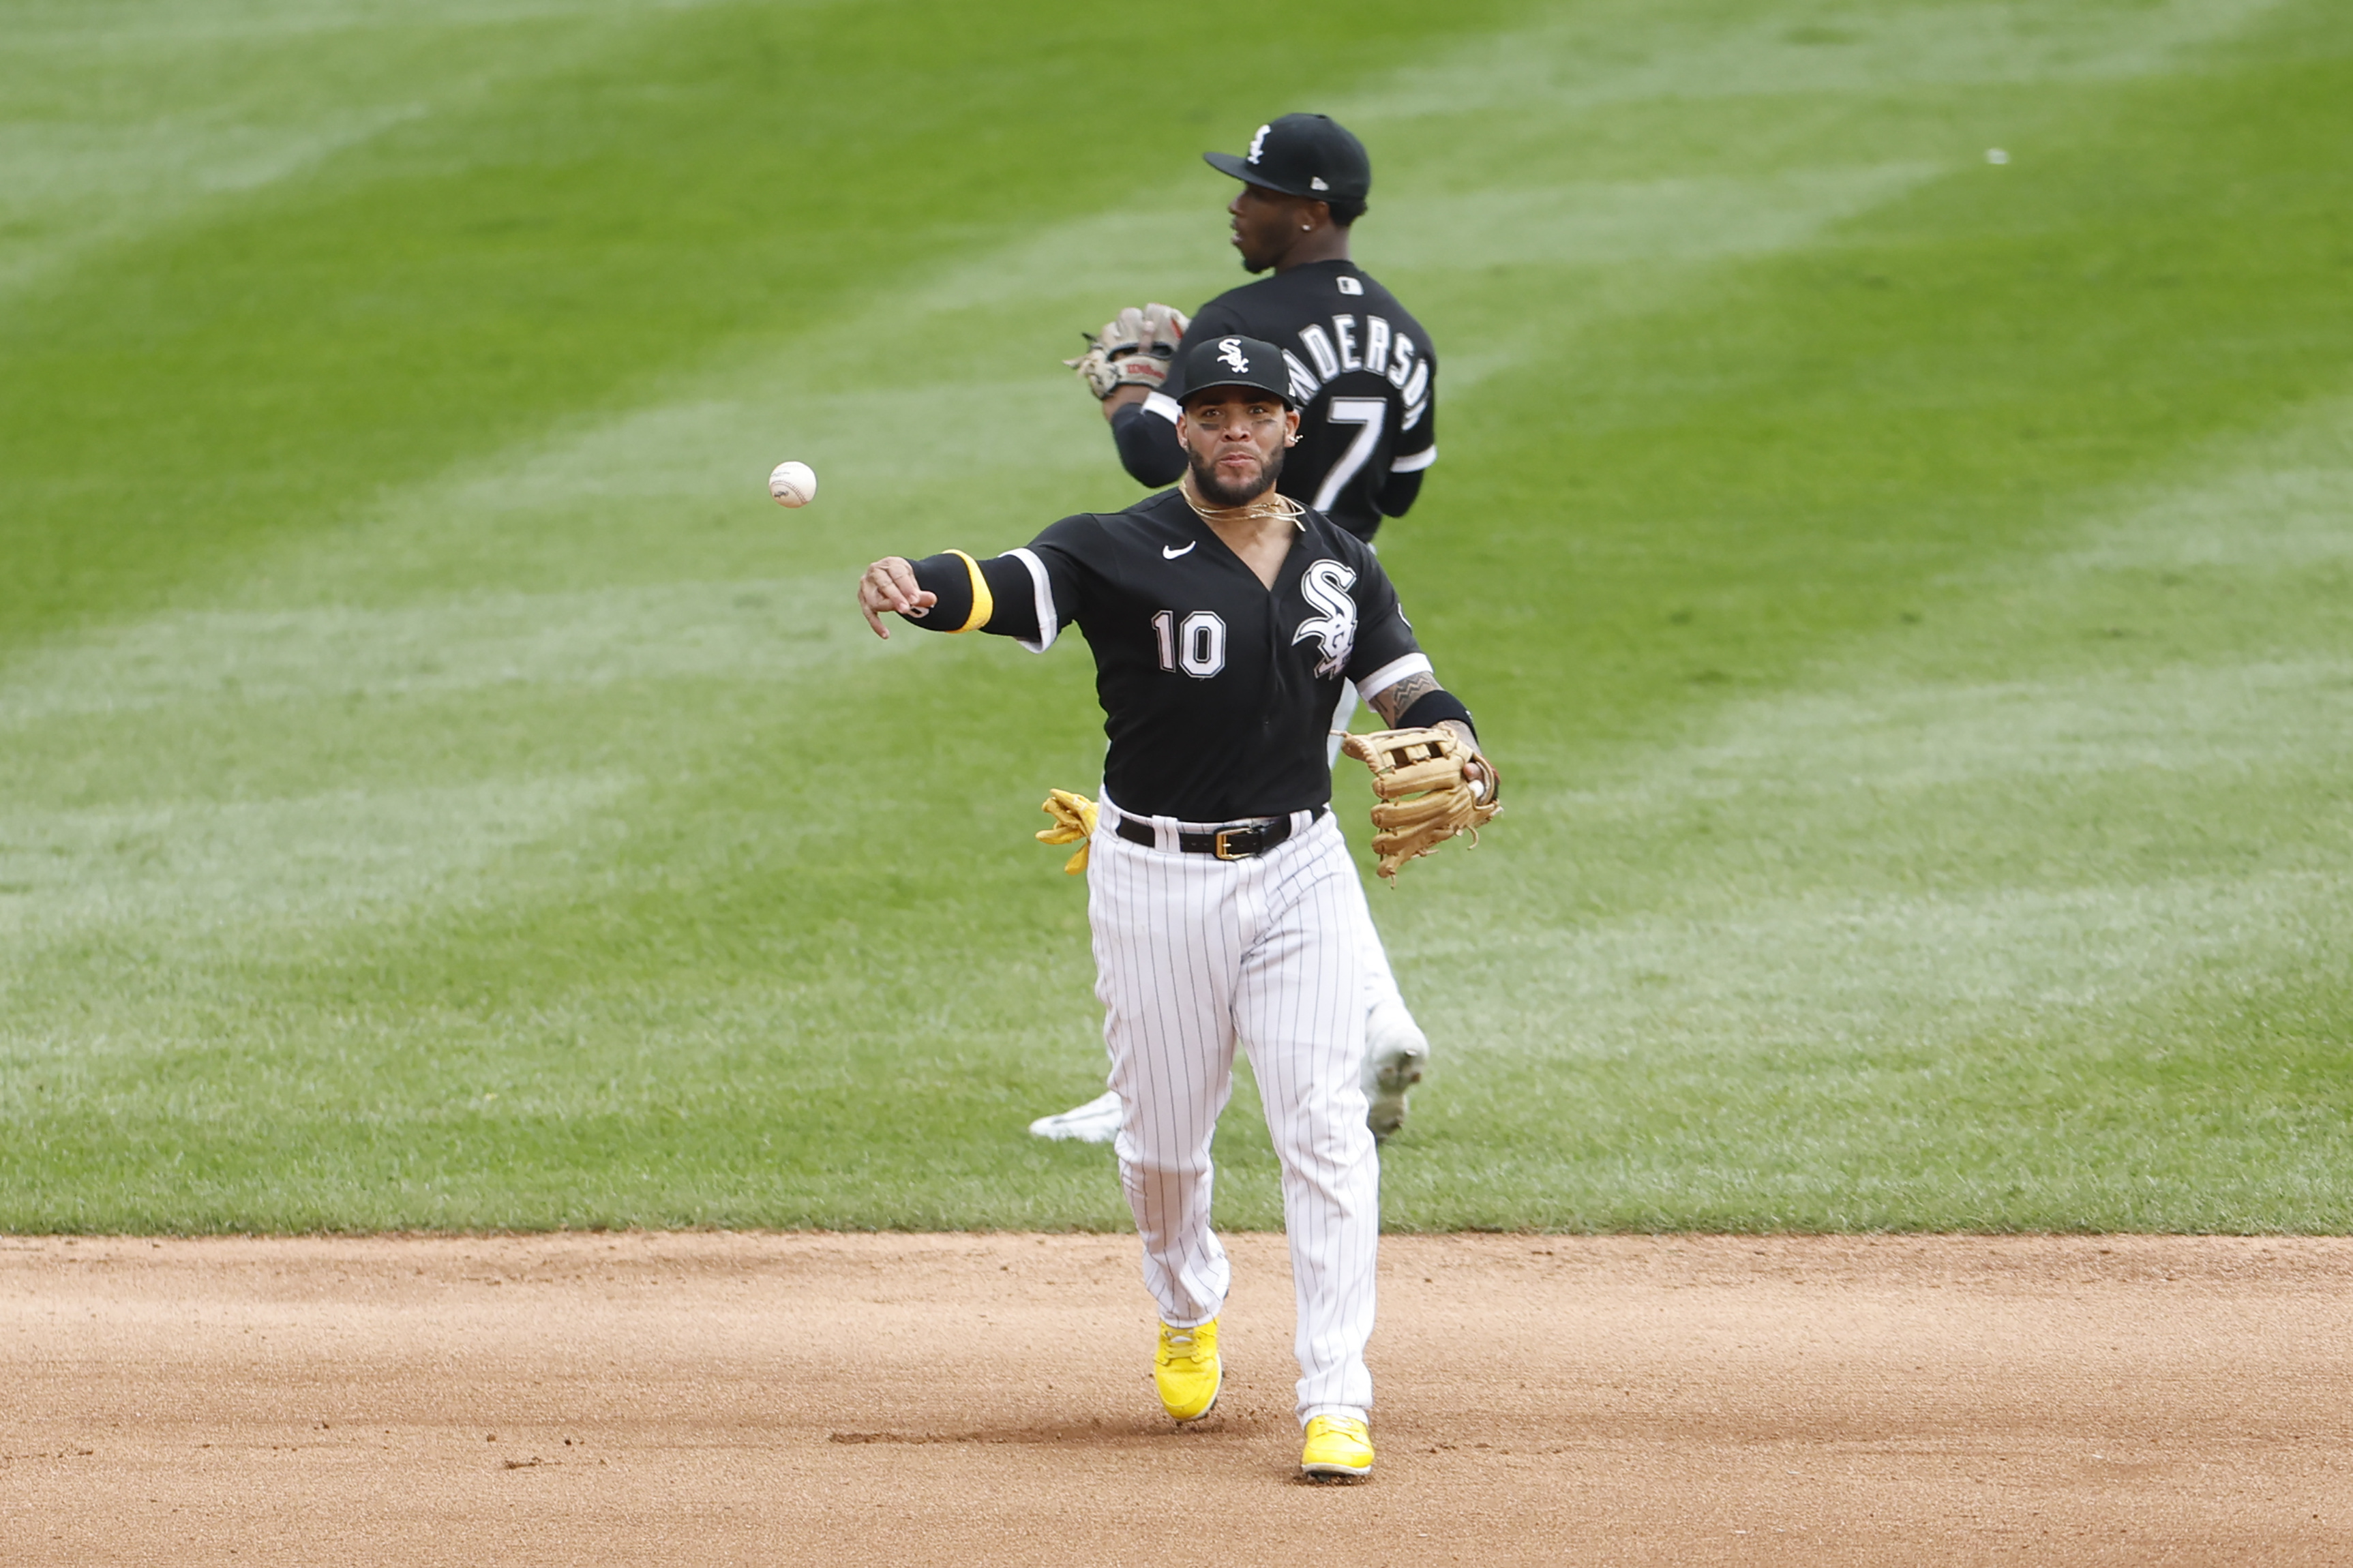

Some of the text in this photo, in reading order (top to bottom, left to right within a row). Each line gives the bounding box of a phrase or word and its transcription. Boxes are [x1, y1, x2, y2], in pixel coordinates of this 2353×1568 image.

[1281, 314, 1430, 432] NDERSO
[1311, 396, 1388, 515] 7
[1150, 609, 1227, 679] 10
